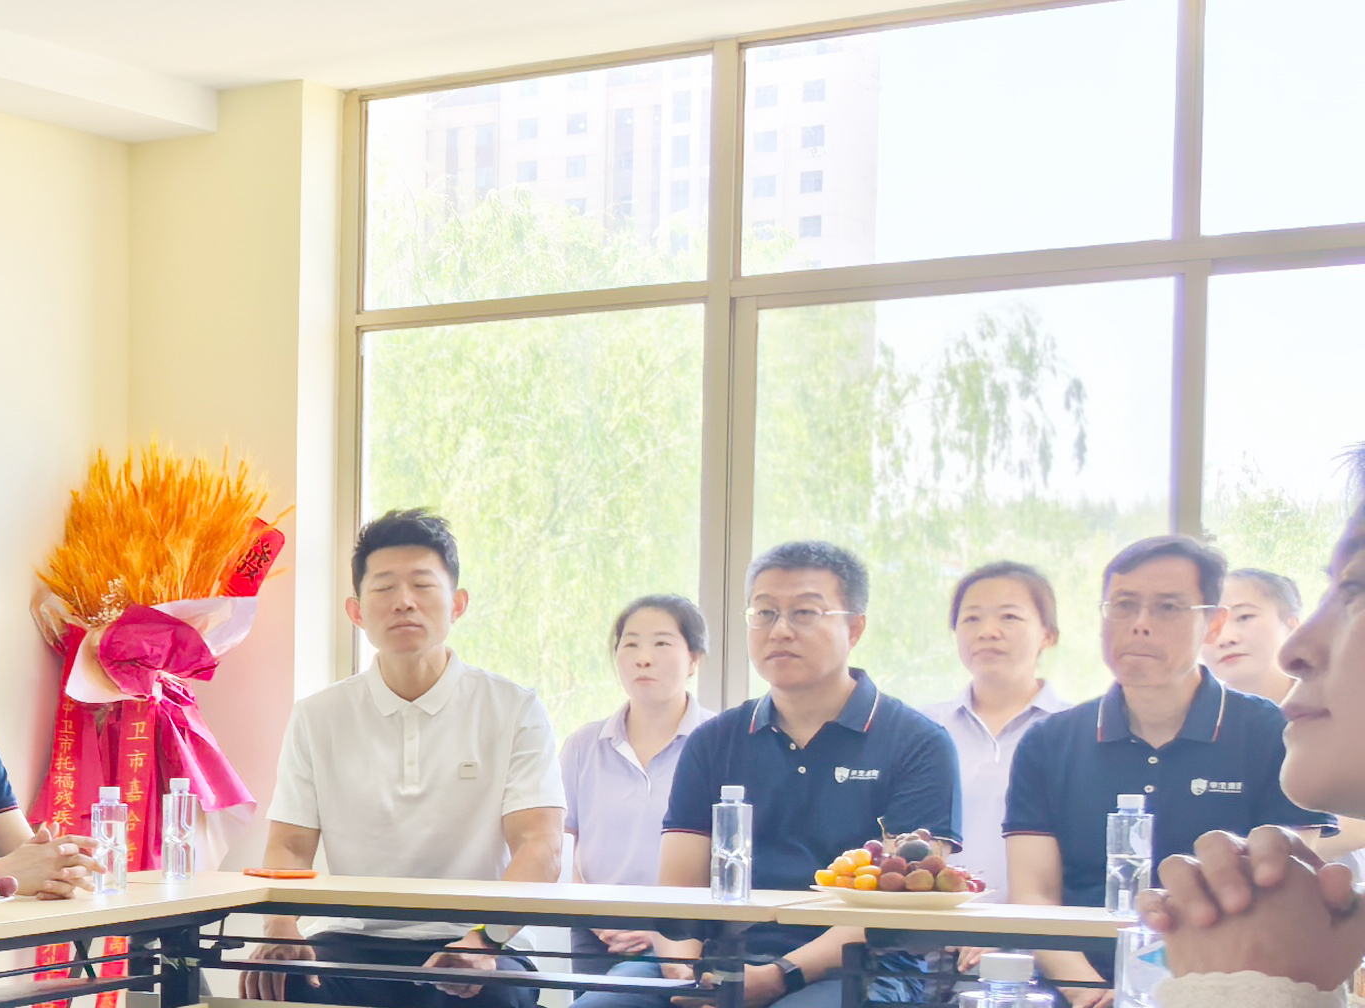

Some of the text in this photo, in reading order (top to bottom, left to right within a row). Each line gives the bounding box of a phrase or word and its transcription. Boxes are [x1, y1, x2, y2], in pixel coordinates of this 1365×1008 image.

[52, 702, 76, 836] 中卫市托福残疾
